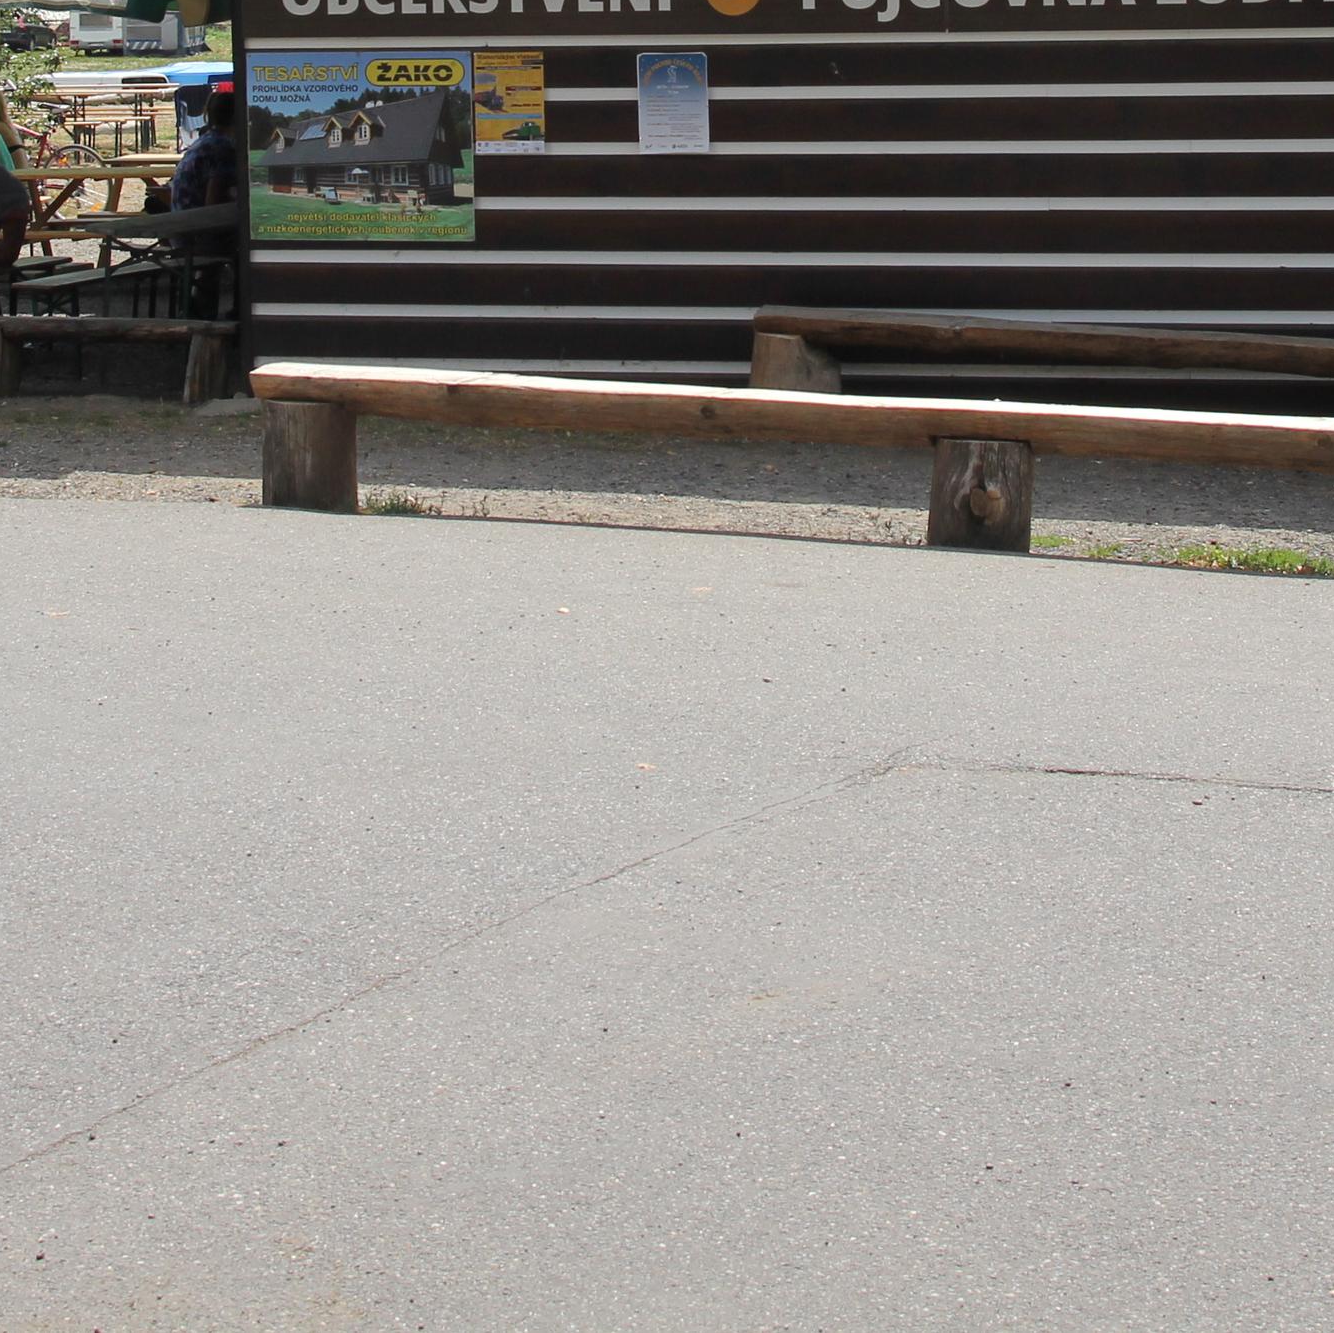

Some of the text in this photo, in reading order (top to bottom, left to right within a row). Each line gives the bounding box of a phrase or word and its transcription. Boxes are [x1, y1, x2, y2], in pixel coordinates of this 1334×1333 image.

[252, 63, 360, 82] TESAŘSTVÍ
[376, 62, 453, 82] ŽAKO
[252, 83, 359, 93] PROHLÍDKA VZOROVÉHO
[252, 92, 311, 103] DOMU MOŽNÁ
